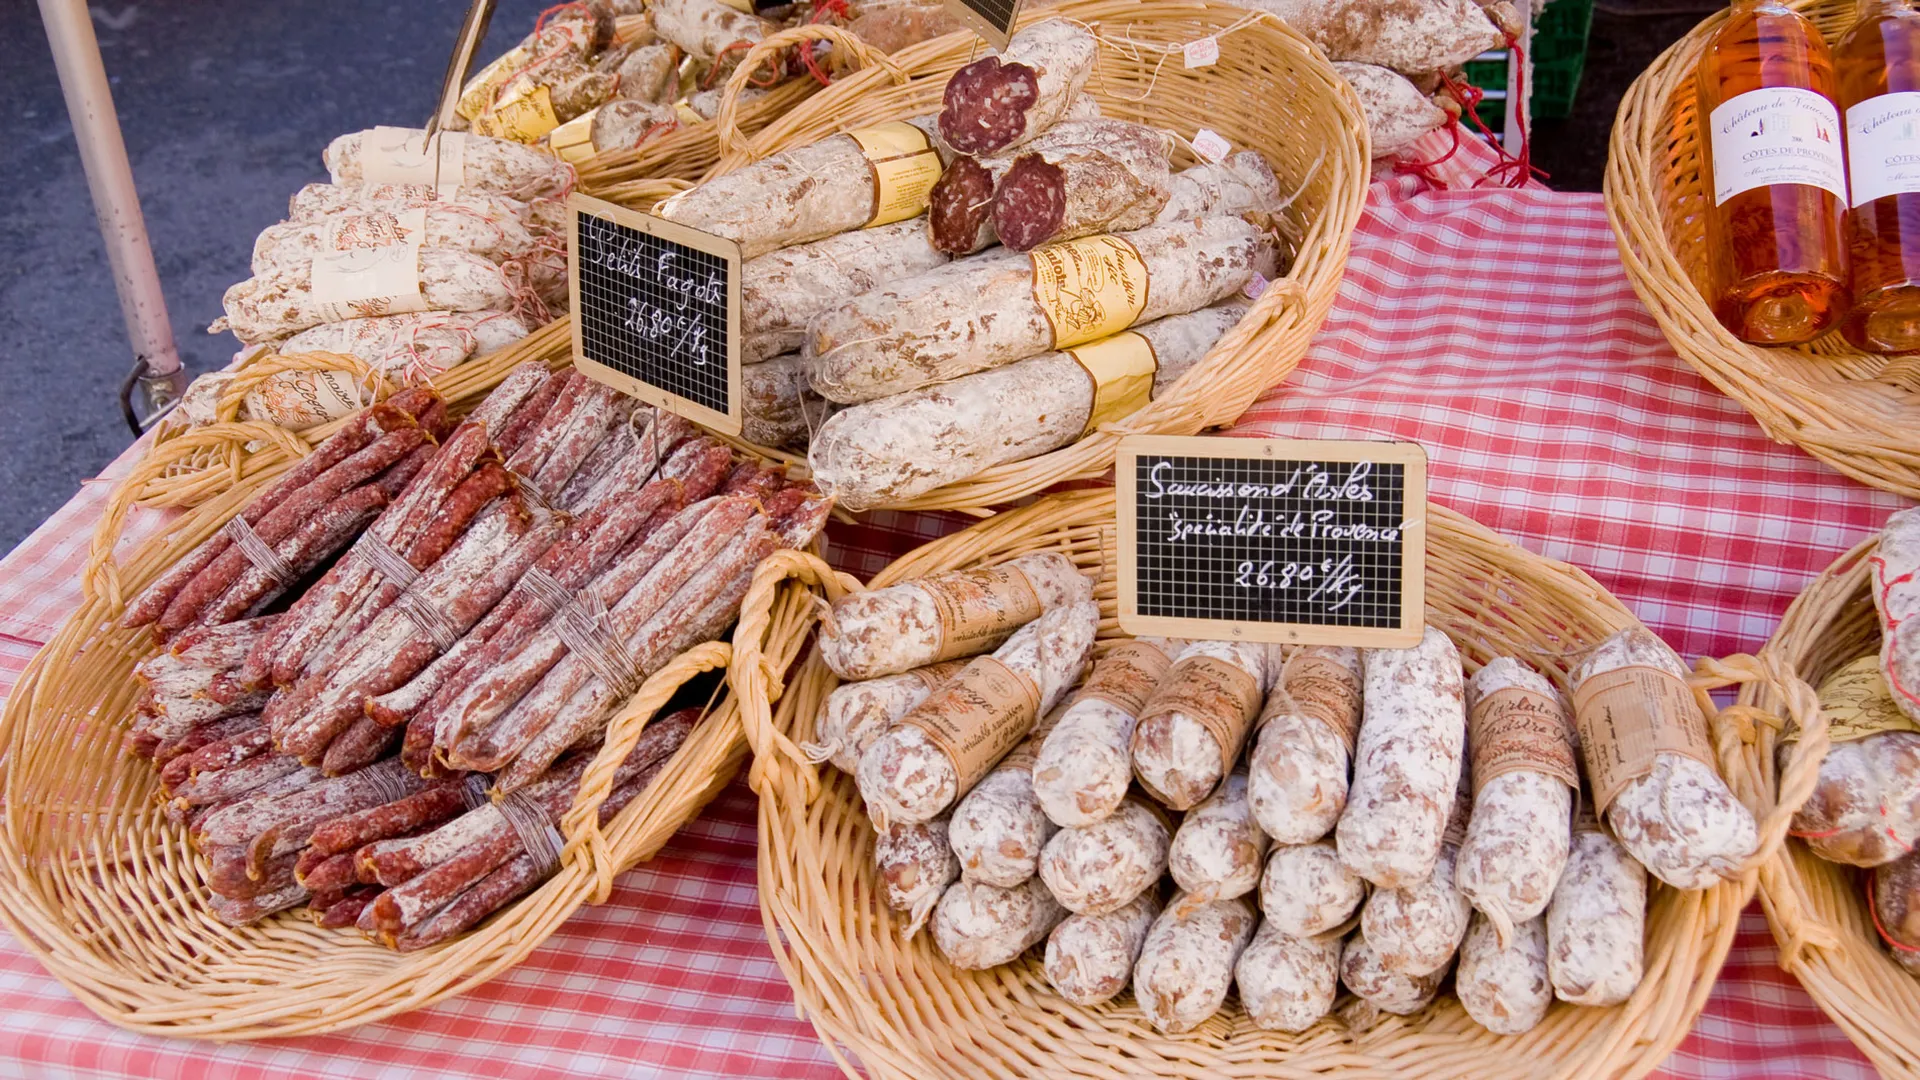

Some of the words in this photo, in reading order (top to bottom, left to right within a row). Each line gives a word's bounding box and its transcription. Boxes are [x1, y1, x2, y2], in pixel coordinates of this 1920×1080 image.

[1772, 97, 1786, 108] de
[1780, 147, 1792, 155] DE
[657, 251, 724, 310] Fagots
[1279, 511, 1305, 538] de
